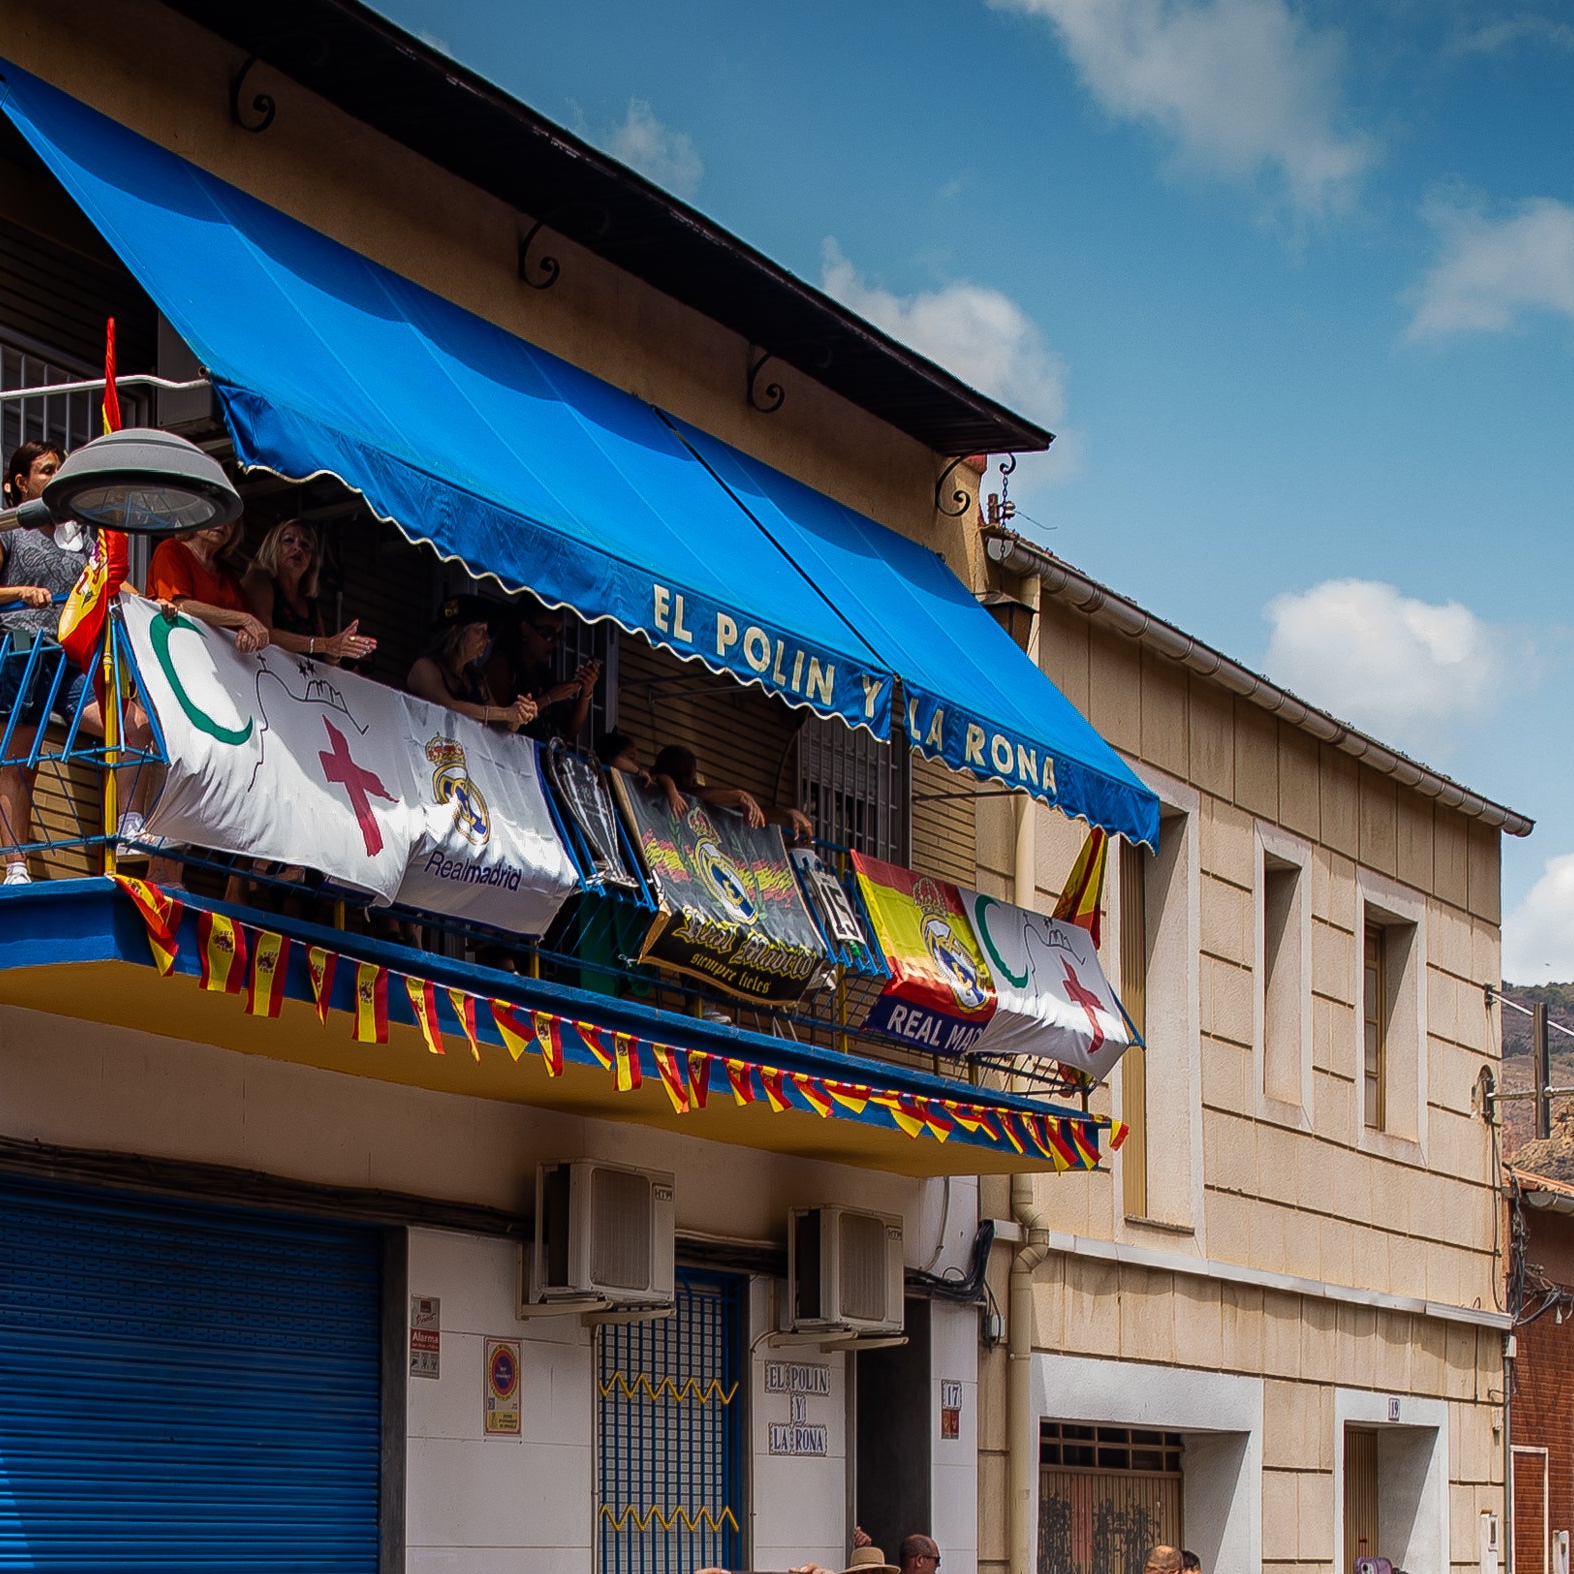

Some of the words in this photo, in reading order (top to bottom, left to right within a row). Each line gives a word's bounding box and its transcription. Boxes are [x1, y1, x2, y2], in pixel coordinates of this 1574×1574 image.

[653, 583, 693, 643] EL
[716, 611, 835, 706] POLIN
[861, 673, 883, 719] Y
[907, 697, 945, 752] LA
[964, 722, 1057, 795] RONA
[424, 850, 523, 892] Realmadrid
[674, 905, 737, 952] Real
[730, 931, 816, 979] Madrid
[689, 952, 738, 982] siempre
[738, 970, 772, 994] fieles
[887, 1004, 942, 1047] REAL
[770, 1366, 784, 1388] EL
[791, 1367, 826, 1392] POLIN
[947, 1385, 959, 1406] 17
[796, 1398, 803, 1421] Y
[773, 1428, 788, 1450] LA
[796, 1428, 824, 1451] RONA
